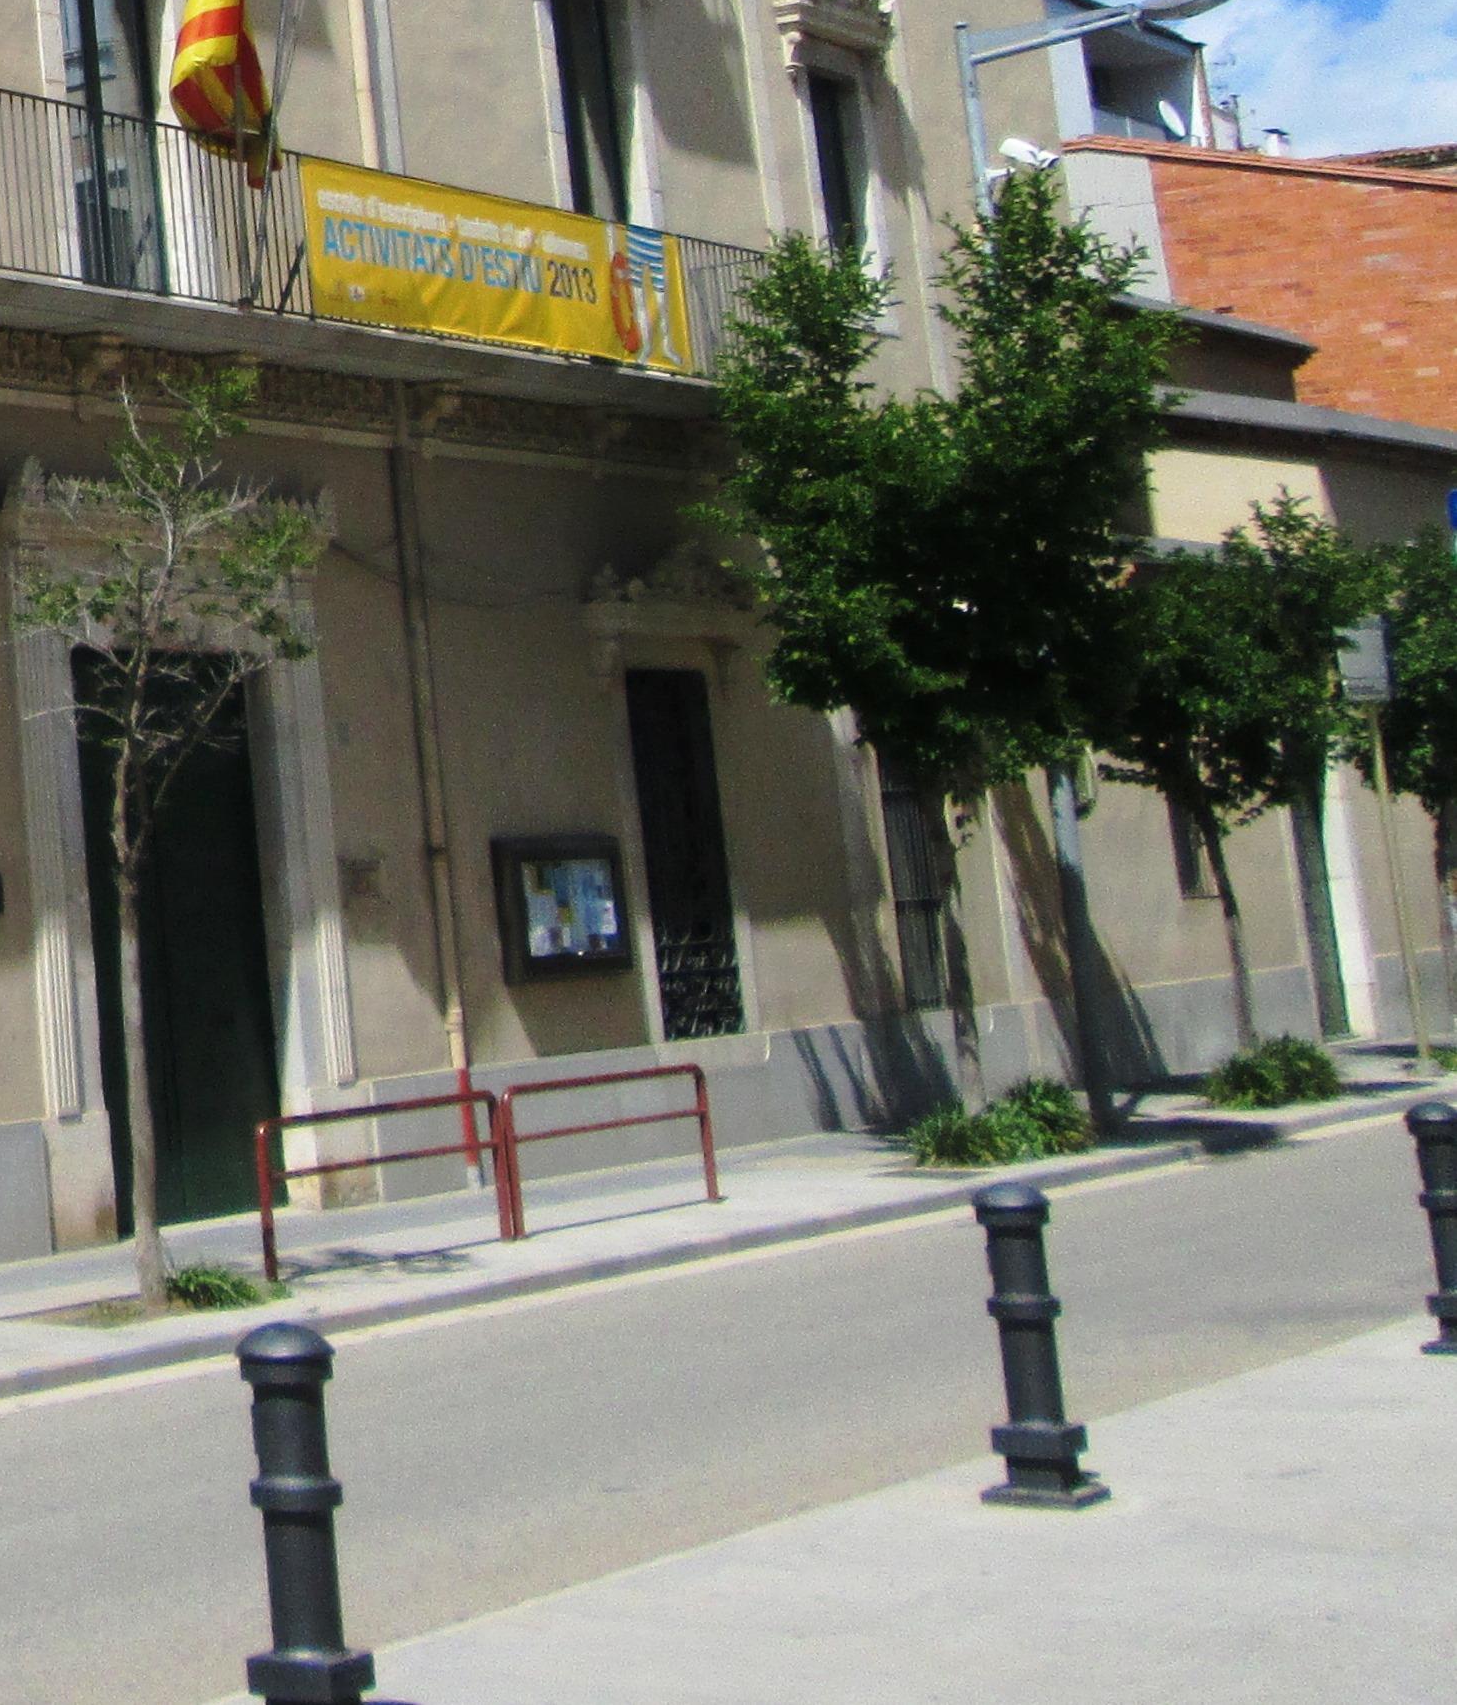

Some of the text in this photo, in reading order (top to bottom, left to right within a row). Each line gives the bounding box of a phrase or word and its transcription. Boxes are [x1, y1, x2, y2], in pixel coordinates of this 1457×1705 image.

[324, 216, 454, 277] ACTIVITATS
[460, 241, 543, 293] D'ESTIU
[547, 259, 598, 305] 2013
